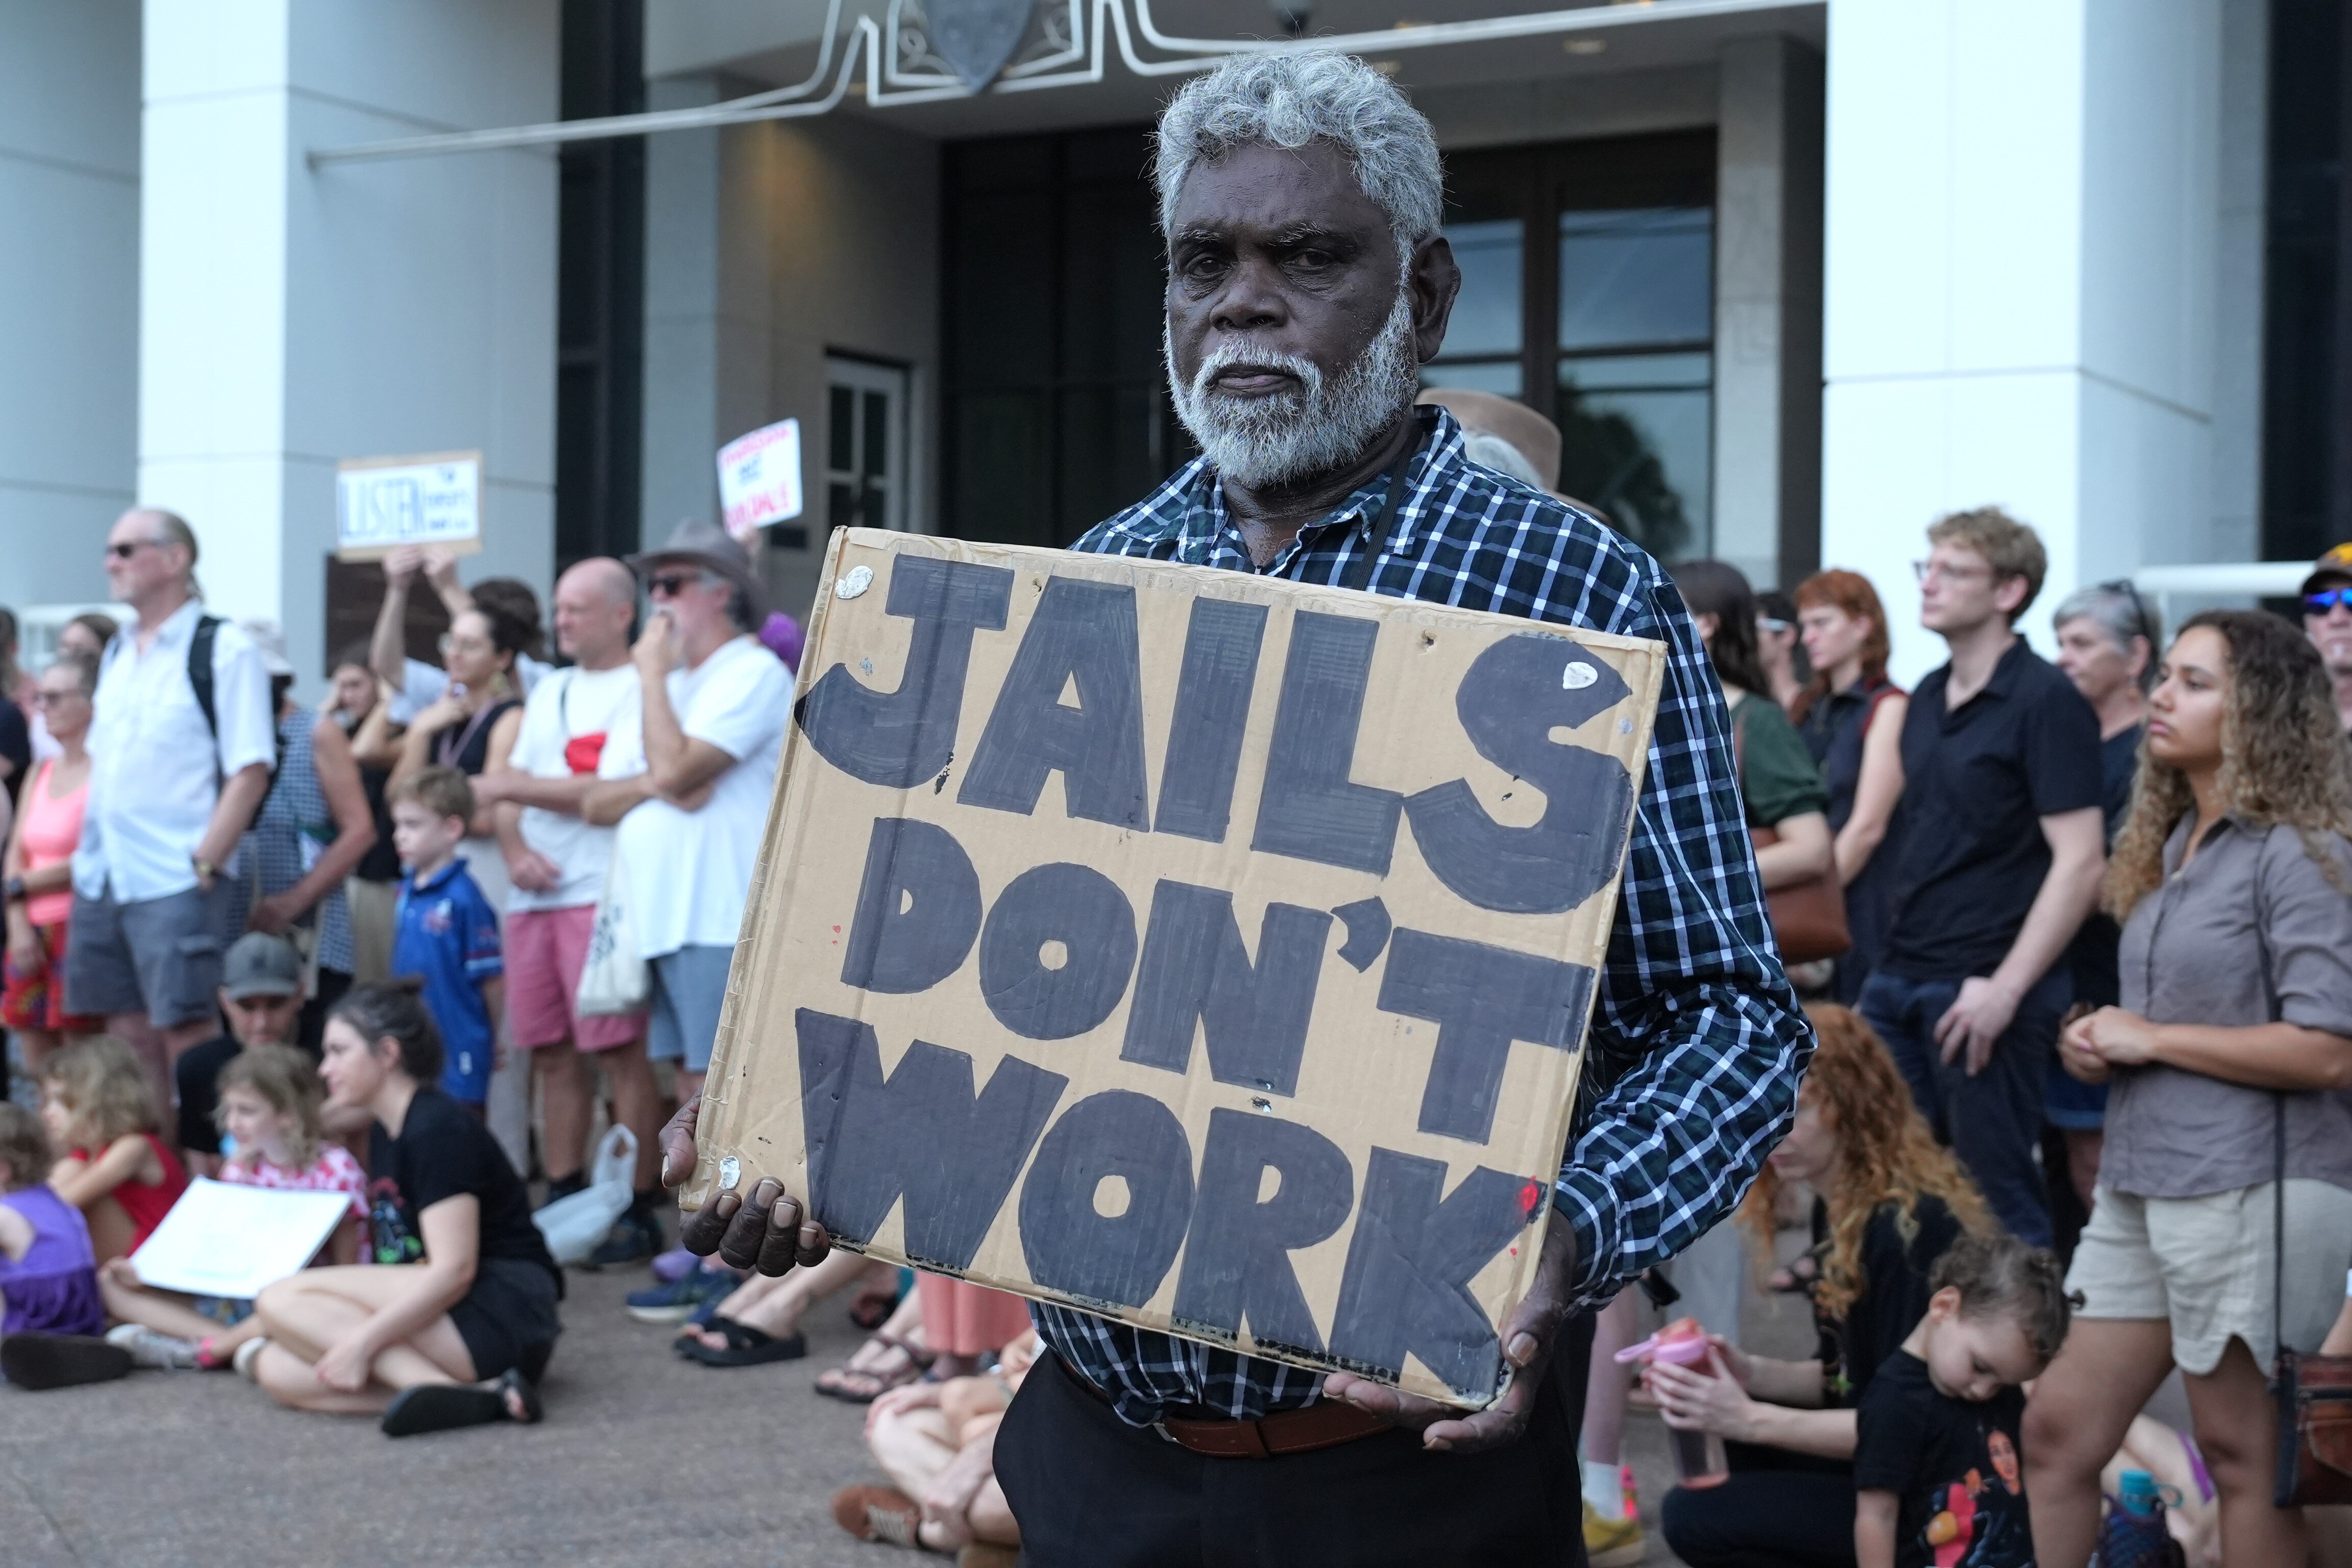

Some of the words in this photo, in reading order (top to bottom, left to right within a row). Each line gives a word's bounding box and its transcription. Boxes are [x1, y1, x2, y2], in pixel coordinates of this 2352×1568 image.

[793, 554, 1634, 914] JAILS
[841, 817, 1597, 1145] DON'T
[795, 1007, 1550, 1398] WORK
